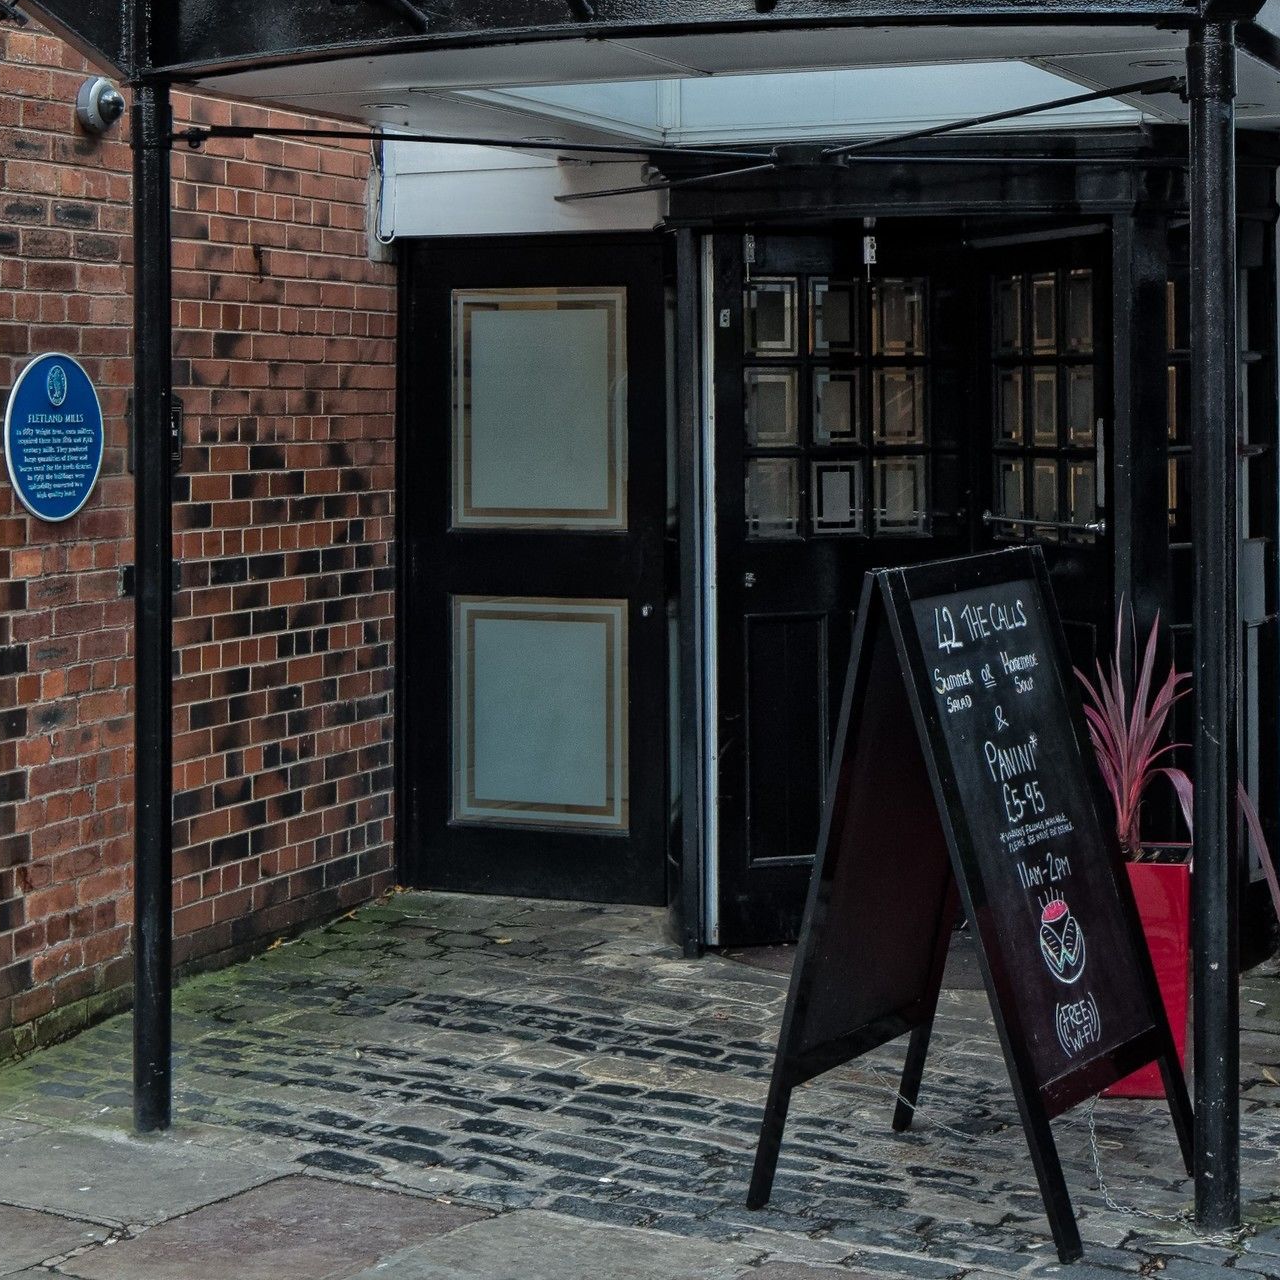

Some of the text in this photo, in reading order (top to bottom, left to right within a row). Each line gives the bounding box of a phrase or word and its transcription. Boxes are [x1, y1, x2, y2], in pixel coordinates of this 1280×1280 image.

[28, 413, 84, 423] FLETLAND MILLS
[934, 599, 1028, 654] 42 THE CALLS
[994, 705, 1009, 732] &
[1060, 1000, 1090, 1031] FREE
